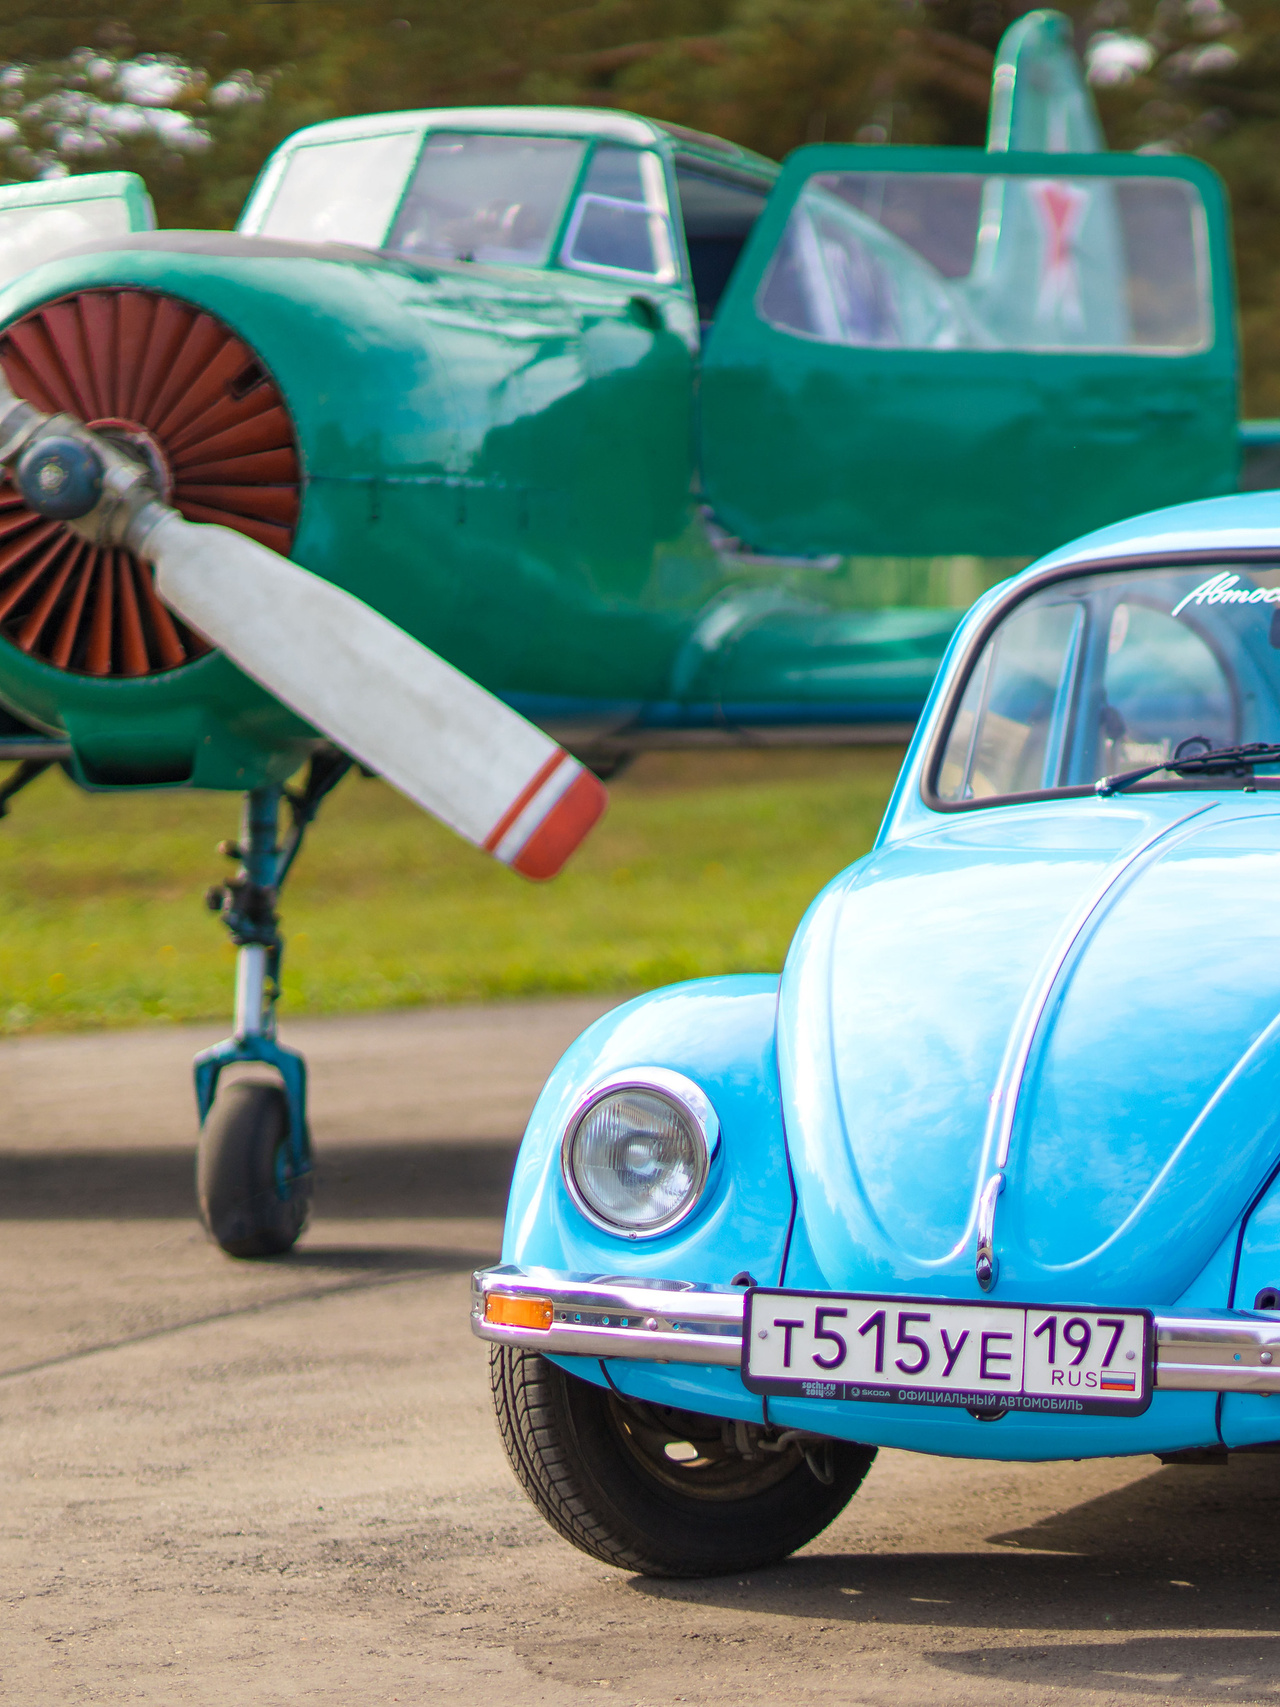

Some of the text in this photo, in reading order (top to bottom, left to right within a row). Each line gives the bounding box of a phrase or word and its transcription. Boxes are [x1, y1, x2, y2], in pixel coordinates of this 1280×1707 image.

[773, 1305, 1126, 1381] Т515УЕ 197
[801, 1381, 837, 1390] sochi.ru
[1051, 1369, 1098, 1389] RUS
[898, 1389, 1084, 1411] ОФИЦИАЛЬНЫЙ АВТОМОБИЛЬ
